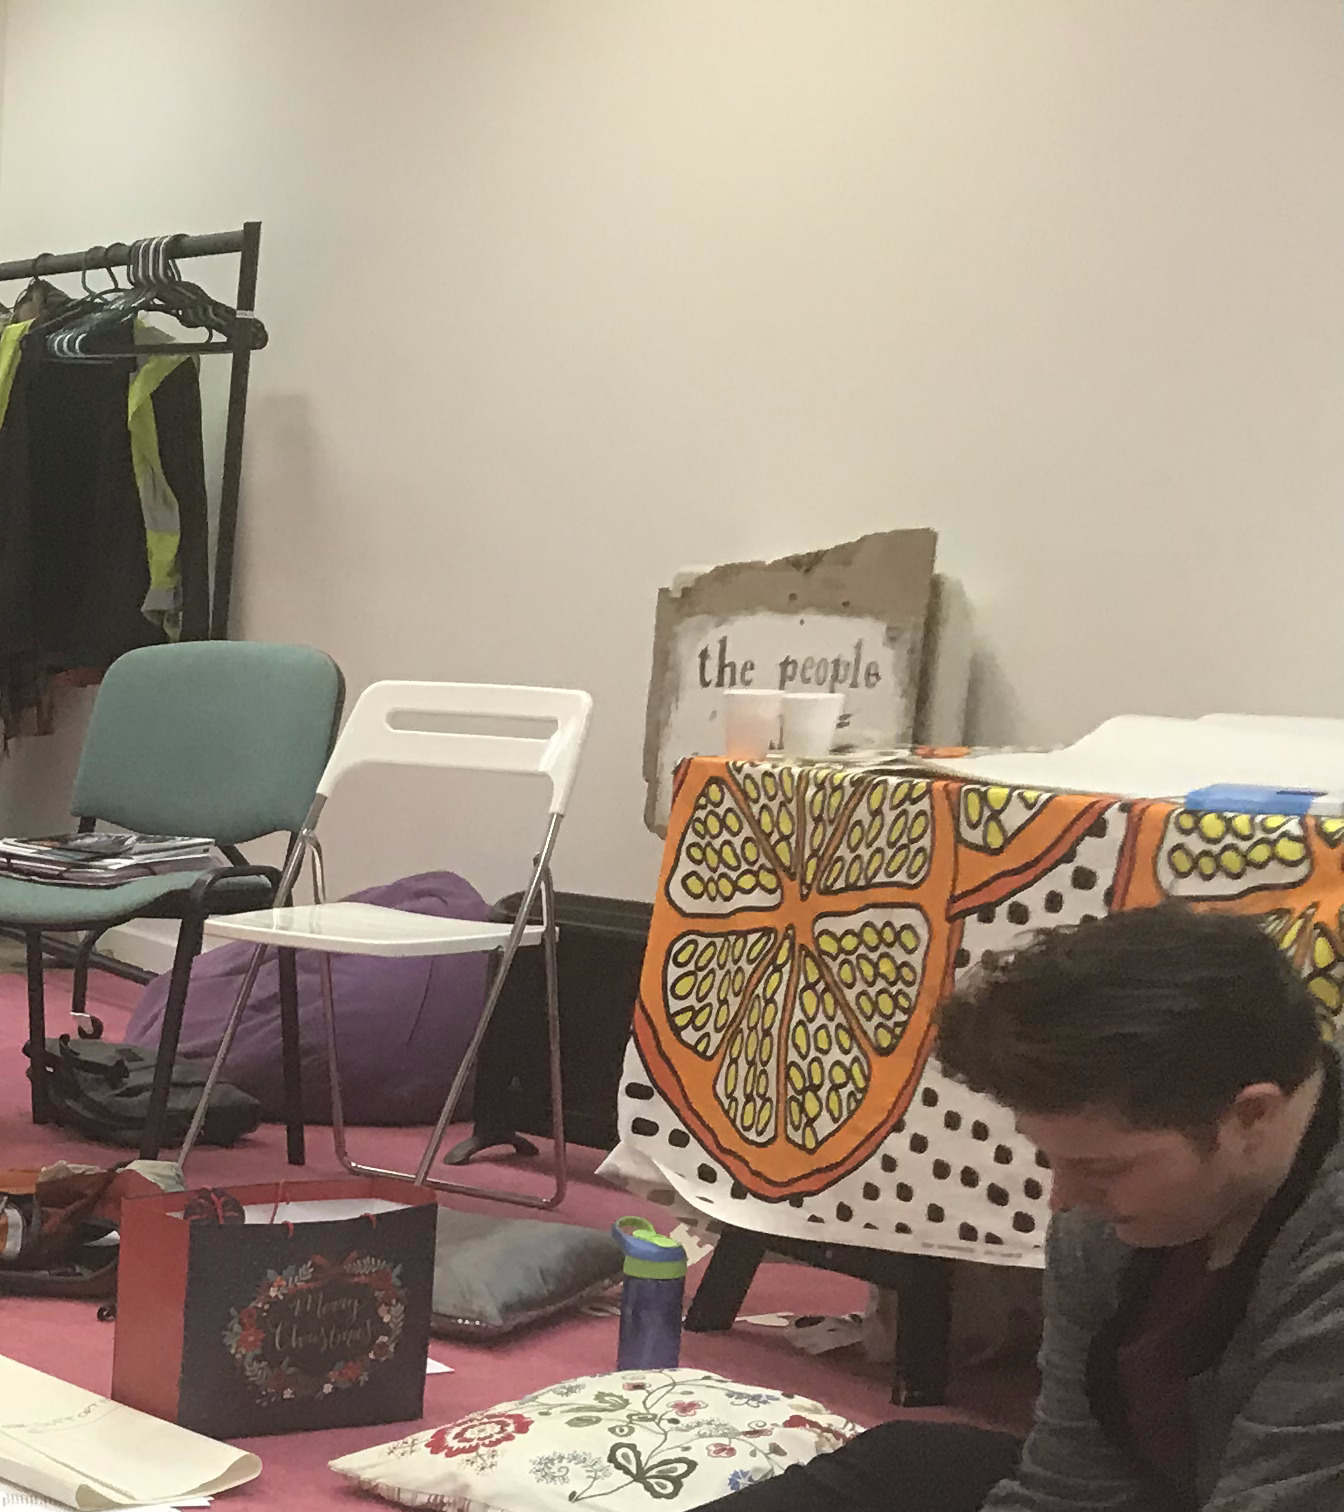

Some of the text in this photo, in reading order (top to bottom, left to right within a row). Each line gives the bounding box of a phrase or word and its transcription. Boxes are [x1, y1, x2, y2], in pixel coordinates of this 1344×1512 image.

[697, 635, 882, 693] the people
[287, 1292, 361, 1323] Merry
